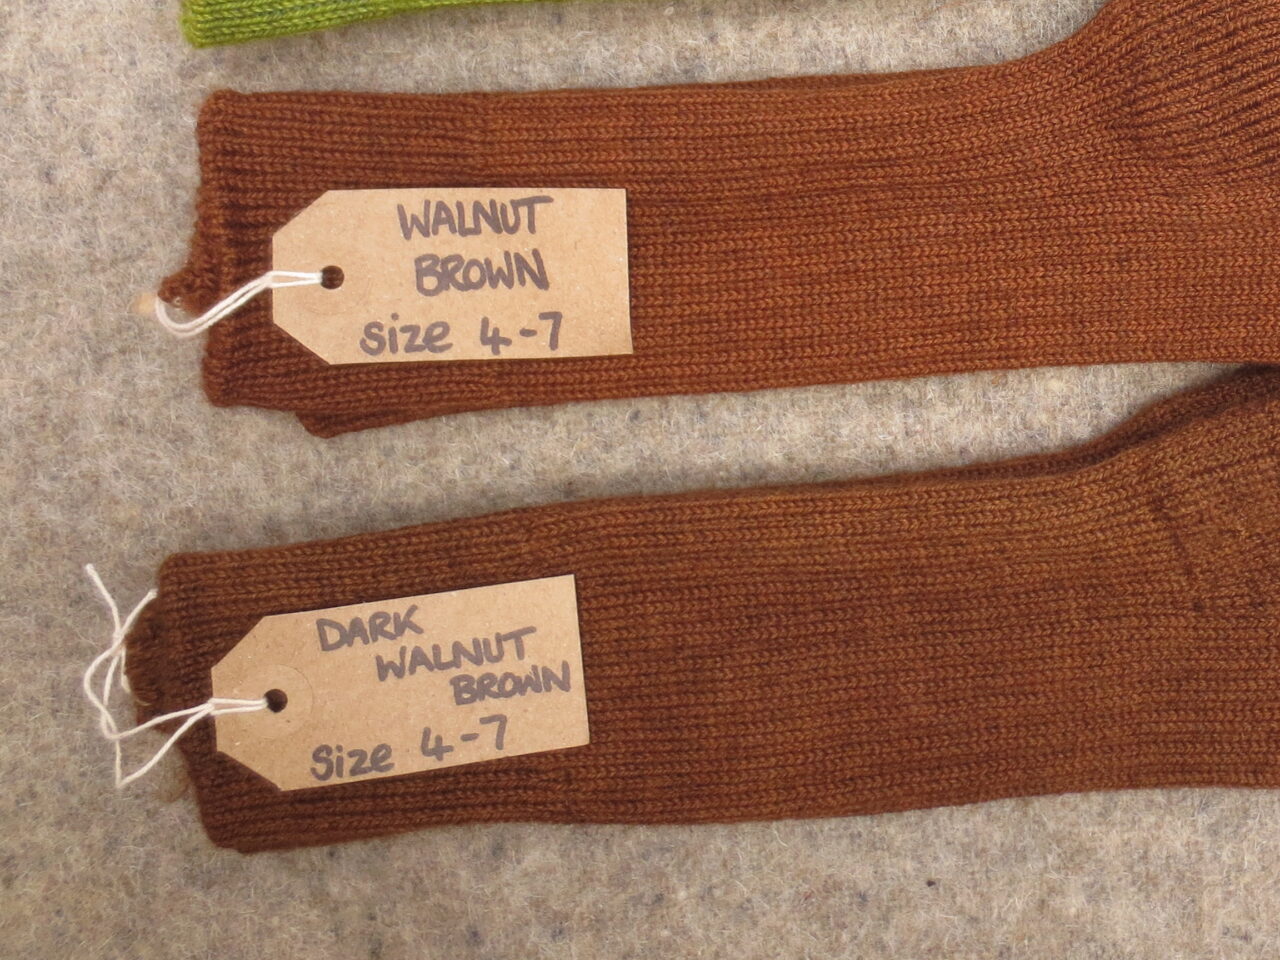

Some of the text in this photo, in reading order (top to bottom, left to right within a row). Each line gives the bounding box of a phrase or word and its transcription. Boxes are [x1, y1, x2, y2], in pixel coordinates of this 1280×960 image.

[397, 195, 554, 240] WALNUT
[414, 248, 550, 296] BROWN
[359, 313, 452, 356] size
[316, 604, 424, 652] DARK
[375, 626, 536, 681] WALNUT
[450, 661, 571, 705] BROWN
